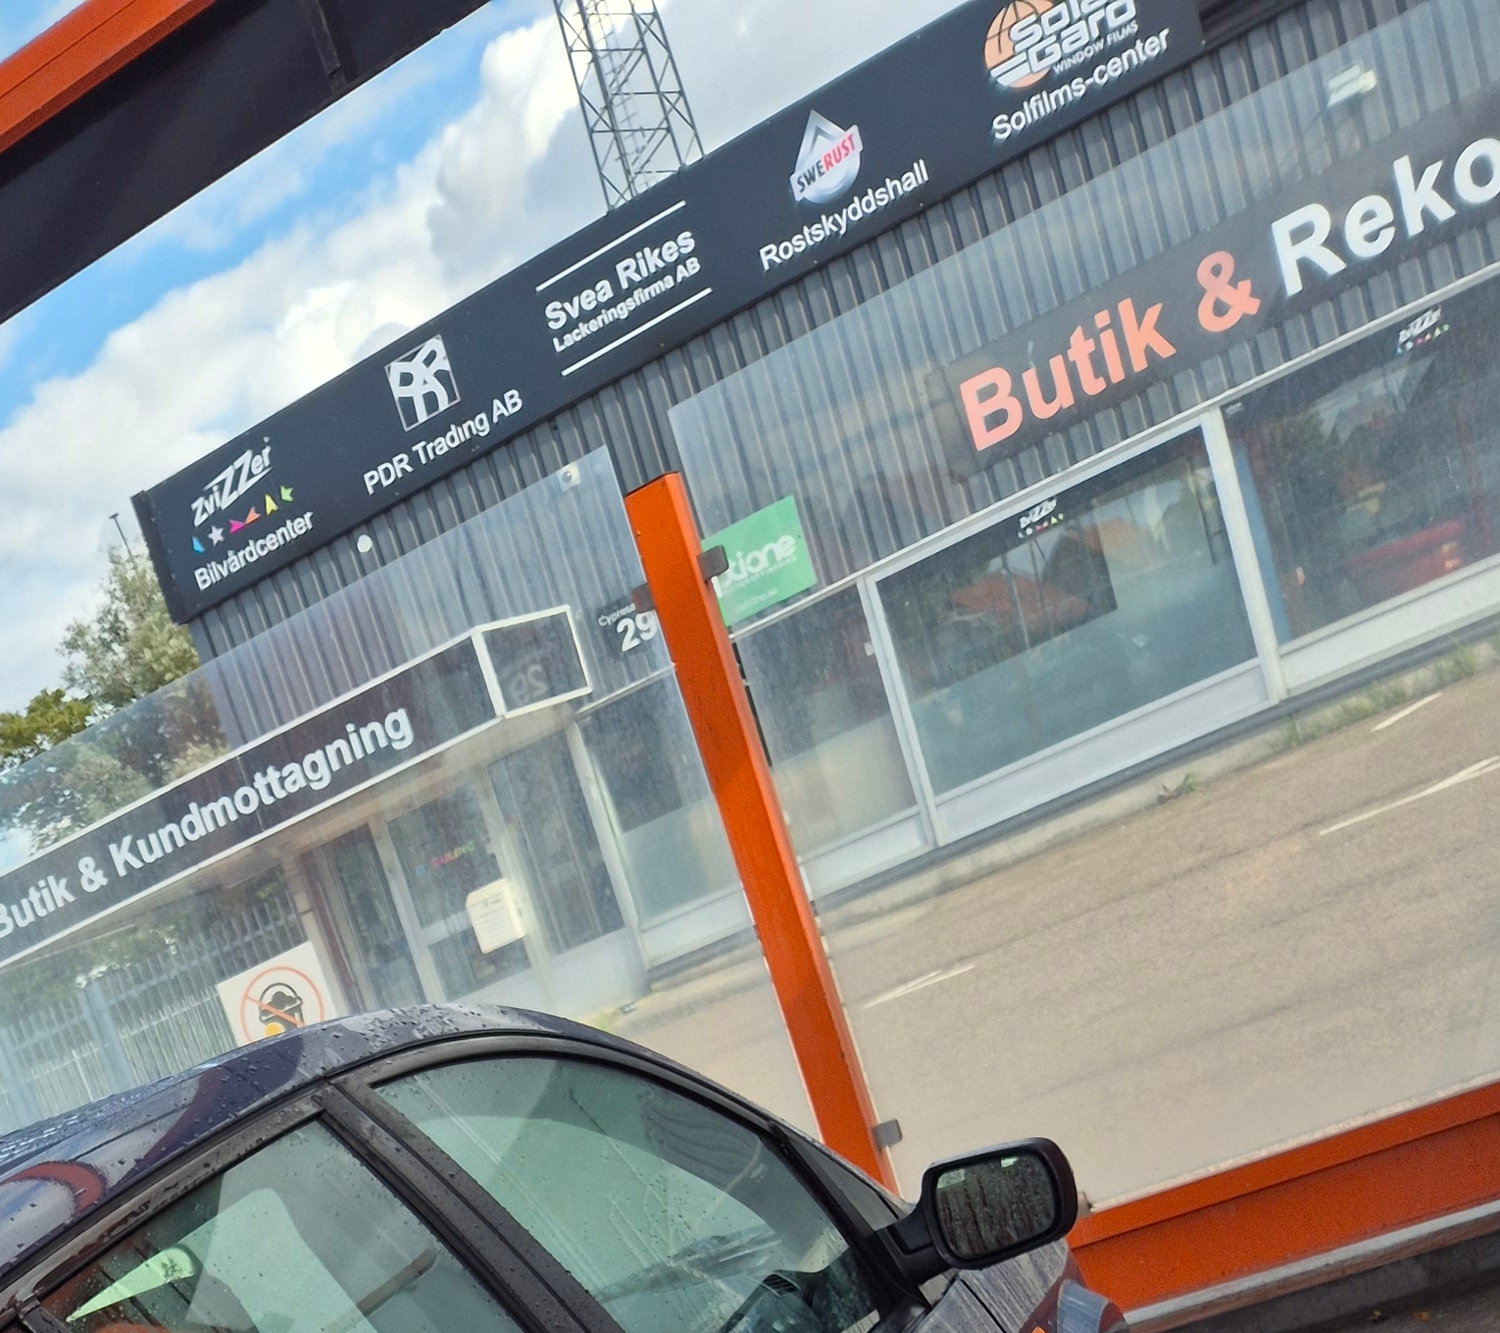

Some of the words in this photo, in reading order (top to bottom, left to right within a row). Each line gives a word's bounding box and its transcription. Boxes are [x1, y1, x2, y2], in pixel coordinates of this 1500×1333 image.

[992, 27, 1170, 140] Solfilms-center
[1052, 39, 1104, 75] WINDOW
[1106, 20, 1139, 46] FILMS
[797, 133, 856, 193] SWERUST
[759, 158, 930, 271] Rostskyddshall
[545, 279, 614, 330] Svea
[615, 231, 696, 290] Rikes
[552, 274, 675, 353] Lackeringsfirma
[675, 257, 701, 283] AB
[959, 297, 1177, 452] Butik
[1196, 250, 1261, 333] &
[363, 453, 414, 496] PDR
[411, 412, 491, 465] Trading
[492, 389, 523, 424] AB
[194, 511, 314, 592] Bilvårdcenter
[616, 609, 658, 652] 29
[77, 856, 108, 894] &
[109, 706, 415, 876] Kundmottagning
